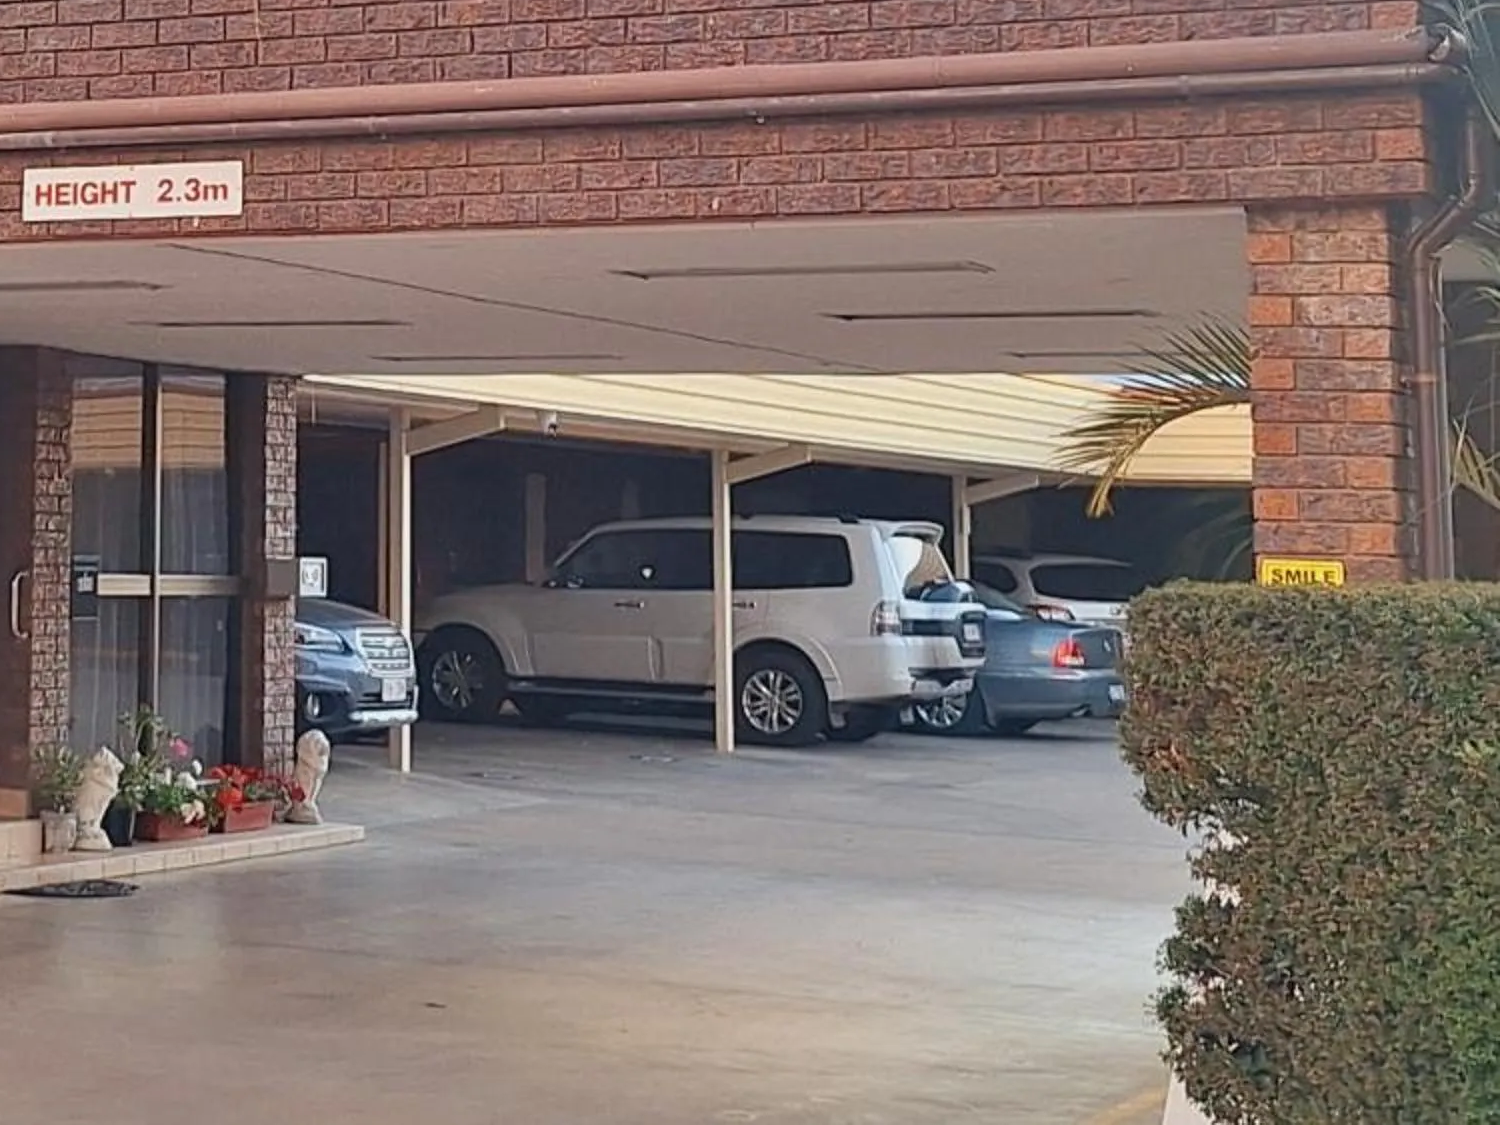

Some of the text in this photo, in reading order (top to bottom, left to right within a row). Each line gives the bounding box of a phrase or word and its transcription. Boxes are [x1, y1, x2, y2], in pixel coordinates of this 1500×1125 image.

[35, 178, 228, 206] HEIGHT 2.3m
[1271, 568, 1336, 584] SMILE
